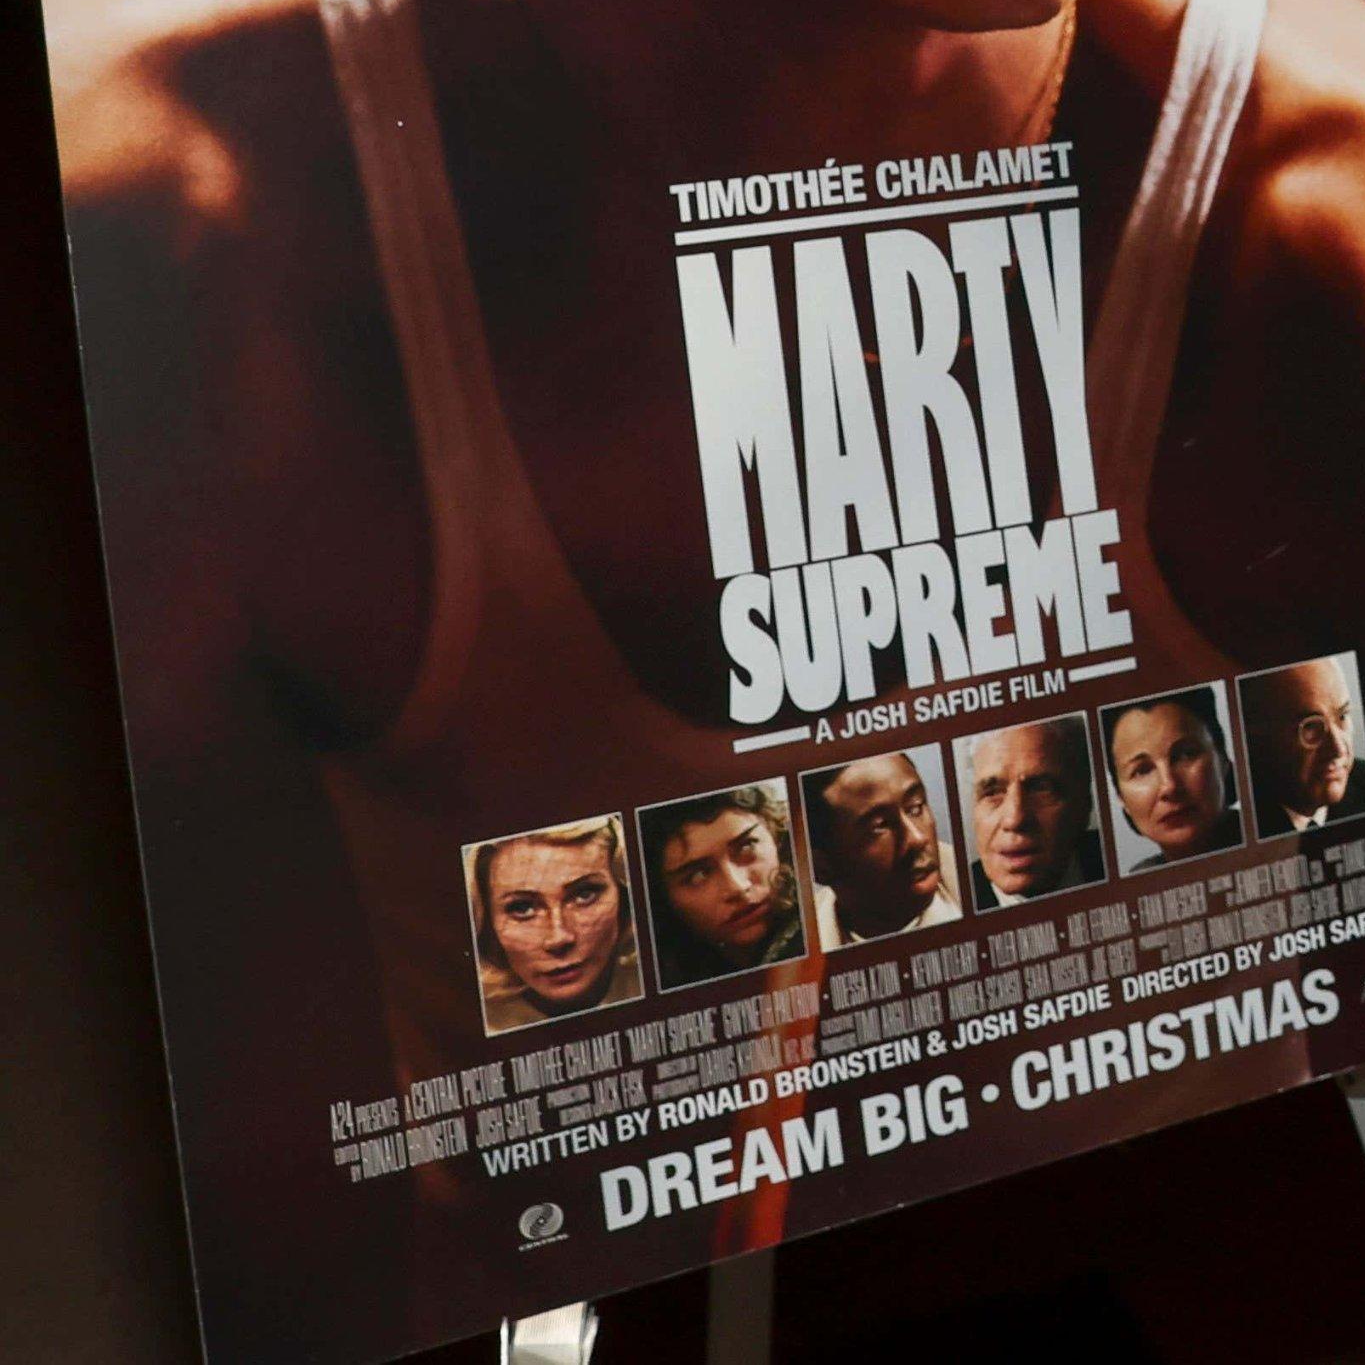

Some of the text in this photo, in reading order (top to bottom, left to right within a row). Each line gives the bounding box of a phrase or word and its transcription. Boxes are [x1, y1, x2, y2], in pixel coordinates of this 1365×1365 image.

[669, 141, 1073, 223] TIMOTHÉE CHALAMET
[675, 208, 1097, 580] MARTY
[719, 508, 1133, 725] SUPREME
[815, 667, 1067, 745] A JOSH SAFDIE FILM
[481, 1119, 609, 1178] WRITTEN
[616, 1107, 653, 1142] BY
[658, 1077, 769, 1132] RONALD
[774, 1034, 923, 1098] BRONSTEIN
[926, 1030, 948, 1058] &
[951, 1011, 1018, 1051] JOSH
[1023, 984, 1112, 1031] SAFDIE
[1122, 951, 1230, 1004] DIRECTED
[1234, 940, 1265, 969] BY
[1268, 922, 1327, 962] JOSH
[599, 1107, 845, 1232] DREAM
[860, 1074, 969, 1157] BIG
[1011, 967, 1341, 1111] CHRISTMAS
